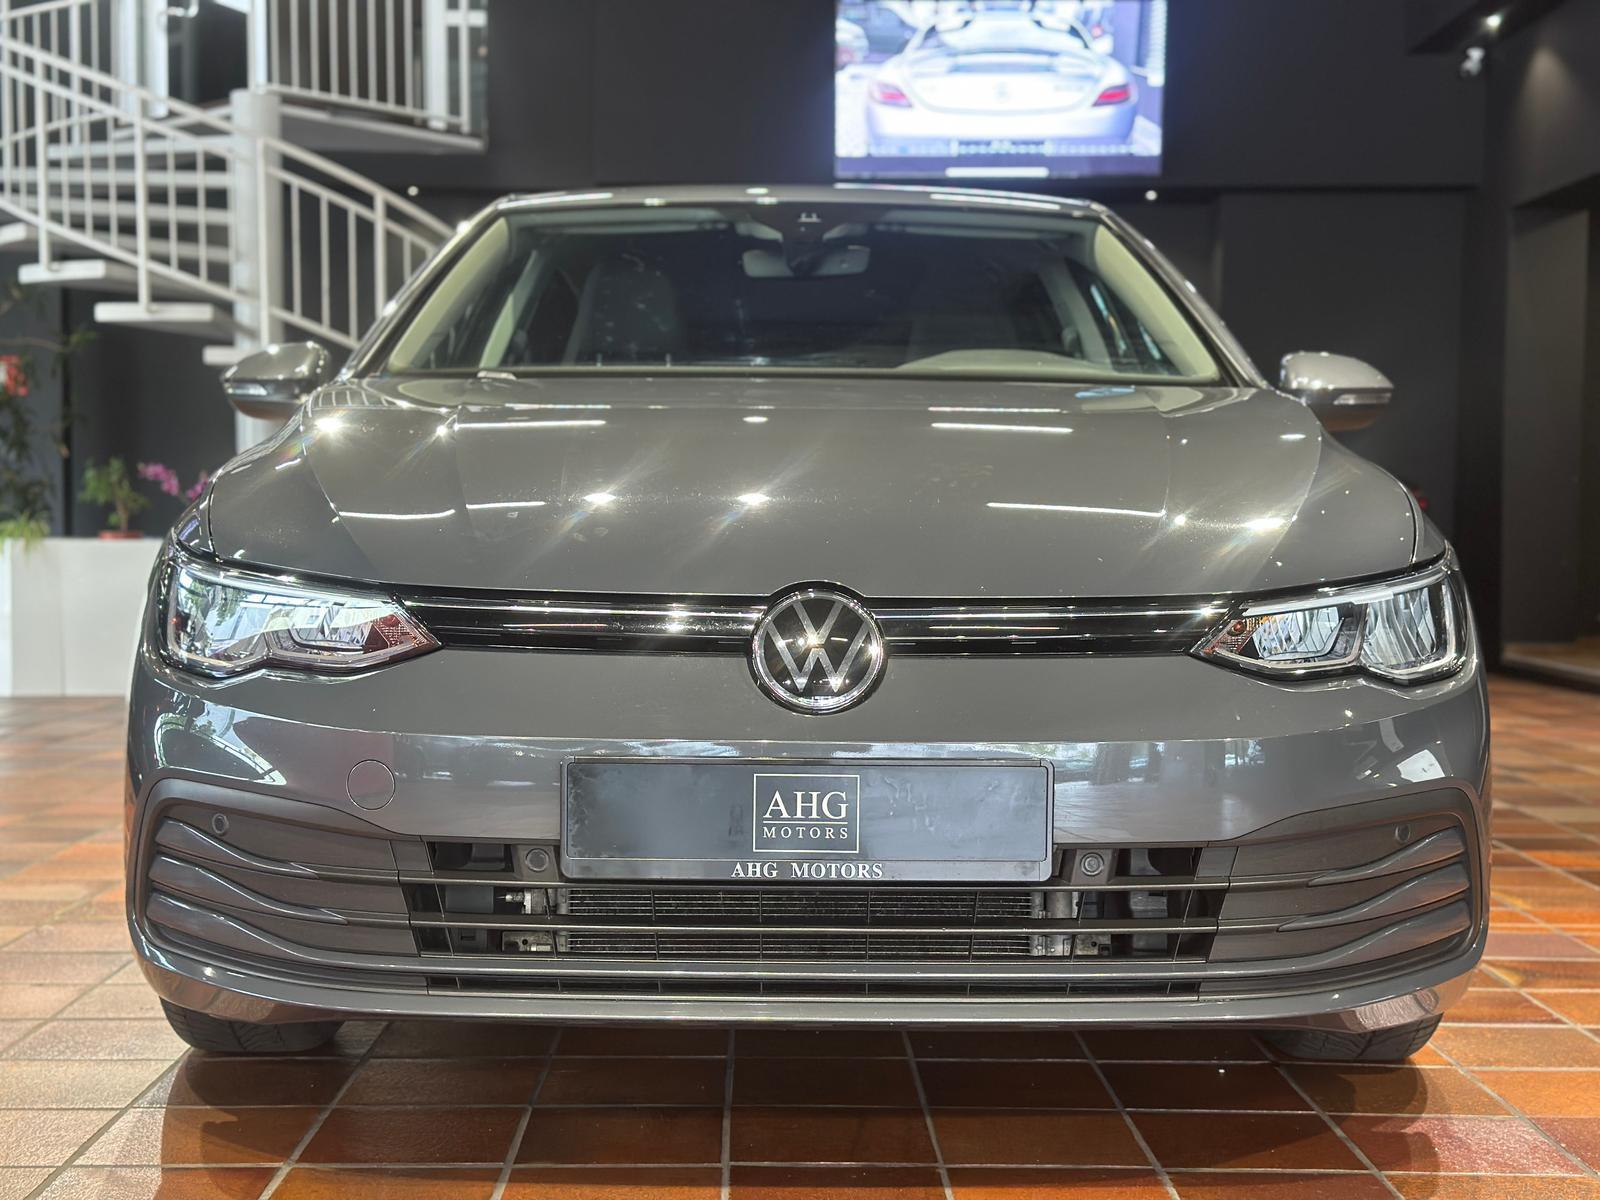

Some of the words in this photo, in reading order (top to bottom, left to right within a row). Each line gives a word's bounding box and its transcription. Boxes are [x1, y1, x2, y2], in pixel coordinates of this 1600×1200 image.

[763, 790, 848, 819] AHG
[763, 826, 848, 839] MOTORS
[731, 862, 778, 878] AHG
[791, 862, 883, 879] MOTORS
